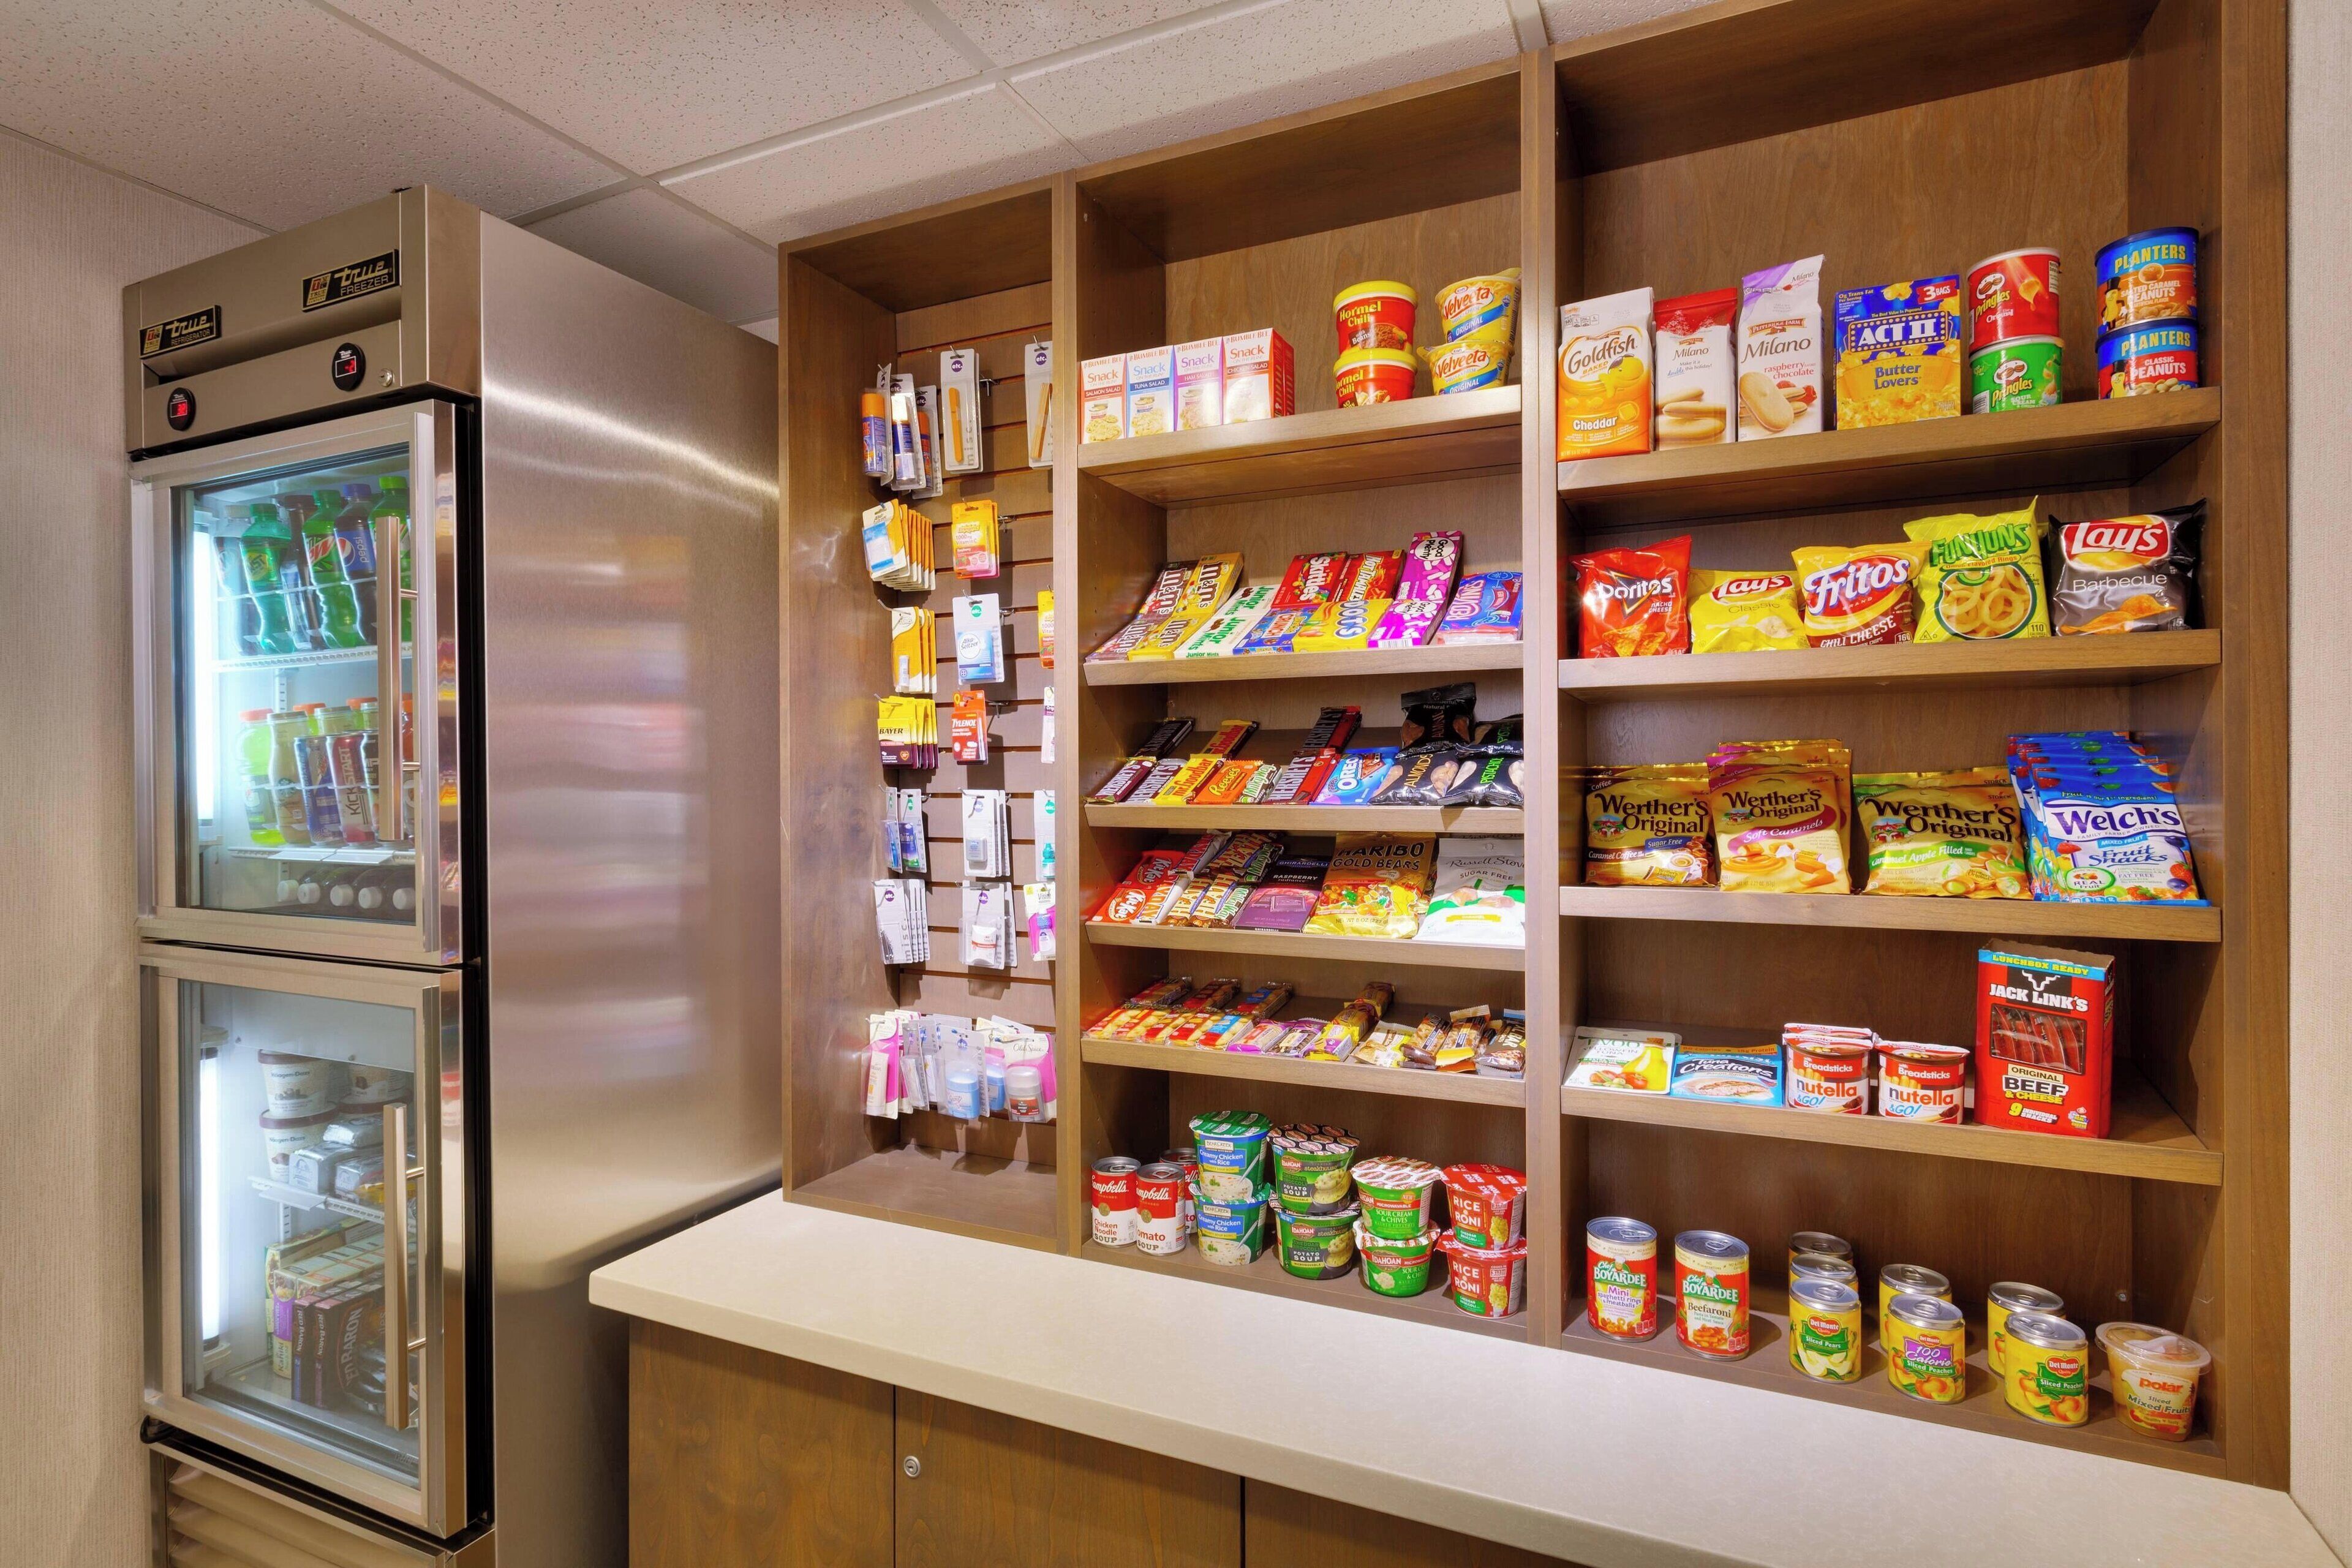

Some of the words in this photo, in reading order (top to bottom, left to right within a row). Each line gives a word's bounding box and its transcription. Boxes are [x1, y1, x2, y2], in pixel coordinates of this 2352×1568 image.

[2114, 244, 2186, 273] PLANTERS
[341, 274, 388, 296] FREEZER
[2149, 280, 2181, 289] CARAMEL
[1923, 285, 1936, 301] 3
[1936, 285, 1950, 296] BAGS
[2128, 288, 2176, 304] PEANUTS
[1444, 286, 1491, 318] Velveeta
[1975, 289, 2010, 322] Pringles
[1340, 301, 1381, 322] Hormel
[1348, 315, 1371, 327] Chili
[1456, 316, 1483, 336] ORIGINAL
[1352, 333, 1371, 344] Beans
[1858, 323, 1905, 346] ACT
[1909, 318, 1937, 339] II
[1231, 344, 1265, 359] Snack
[1741, 336, 1811, 364] Milano
[2121, 331, 2191, 356] PLANTERS
[1182, 353, 1214, 368] Snack
[1568, 333, 1637, 375] Goldfish
[1672, 347, 1709, 361] Milano
[2145, 356, 2174, 366] CLASSIC
[1134, 363, 1166, 376] Snack
[1436, 350, 1488, 377] Velveeta
[1582, 360, 1609, 375] BAKED
[1763, 361, 1806, 375] raspberry
[1875, 364, 1921, 378] Butter
[2130, 363, 2186, 380] PEANUTS
[1088, 369, 1118, 383] Snack
[1773, 368, 1814, 380] chocolate
[1339, 383, 1355, 397] Chili
[1449, 379, 1479, 394] ORIGINAL
[1874, 377, 1918, 390] Lovers
[1992, 377, 2032, 407] Pringles
[1572, 416, 1618, 431] Cheddar
[2069, 522, 2163, 555] Lay's
[359, 536, 369, 564] pepsi
[1435, 539, 1449, 557] Good
[1300, 556, 1330, 601] Skittles
[2073, 573, 2168, 593] Barbecue
[1597, 576, 1672, 600] Doritos
[1803, 559, 1910, 616] Fritos
[1243, 586, 1275, 609] Junior
[1728, 601, 1781, 614] Classic
[1335, 600, 1370, 639] DOTS
[1211, 617, 1246, 644] Junior
[1849, 615, 1896, 644] CHEESE
[960, 641, 979, 650] Seltzer
[1188, 632, 1215, 650] Mints
[951, 719, 976, 728] TYLENOL
[1337, 757, 1359, 789] OREO
[1403, 753, 1433, 788] ALMONDS
[1208, 767, 1241, 796] Reese's
[1594, 793, 1709, 817] Werther's
[1722, 788, 1822, 809] Werther's
[1749, 802, 1820, 820] Original
[1865, 796, 2018, 826] Werther's
[1622, 814, 1704, 837] Original
[2051, 807, 2180, 835] Welch's
[1744, 829, 1768, 843] Soft
[1770, 818, 1823, 837] Caramels
[1905, 816, 2013, 843] Original
[1648, 839, 1667, 848] Sugar
[2124, 835, 2143, 844] FRUIT
[1337, 842, 1425, 857] HARIBO
[1908, 849, 1936, 864] Apple
[1938, 845, 1964, 856] Filled
[1333, 859, 1371, 868] GOLD
[1378, 859, 1420, 870] BEARS
[1450, 858, 1492, 867] Russell
[2089, 854, 2168, 867] Snacks
[1460, 870, 1488, 879] SUGAR
[1992, 954, 2049, 969] LUNCHBOX
[2052, 963, 2089, 975] READY
[1989, 983, 2029, 1003] JACK
[2032, 991, 2089, 1012] LINK'S
[1680, 1063, 1773, 1077] Creations
[1803, 1060, 1853, 1072] Breadsticks
[1898, 1066, 1950, 1079] Breadsticks
[2011, 1066, 2060, 1083] ORIGINAL
[1796, 1077, 1857, 1098] nutella
[2004, 1076, 2067, 1097] BEEF
[1890, 1087, 1954, 1106] nutella
[2016, 1091, 2063, 1104] CHEESE
[1200, 1150, 1218, 1159] Creamy
[1453, 1196, 1480, 1212] RICE
[1095, 1219, 1117, 1229] Chicken
[1199, 1214, 1215, 1225] Creamy
[1455, 1213, 1481, 1227] RONI
[1095, 1226, 1117, 1235] Noodle
[1095, 1234, 1117, 1243] SOUP
[1137, 1240, 1159, 1251] SOUP
[1372, 1256, 1401, 1264] IDAHOAN
[1453, 1261, 1479, 1278] RICE
[1594, 1267, 1647, 1287] BOYARDEE
[1455, 1279, 1480, 1294] RONI
[1608, 1285, 1630, 1297] Mini
[1683, 1281, 1739, 1303] BOYARDEE
[1687, 1302, 1731, 1318] Beefaroni
[1820, 1321, 1839, 1330] Monte
[1806, 1335, 1823, 1345] Sliced
[1825, 1339, 1841, 1349] Pears
[1928, 1365, 1953, 1374] Peaches
[2049, 1360, 2060, 1369] Del
[2060, 1361, 2079, 1370] Monte
[2040, 1379, 2061, 1389] Sliced
[2128, 1394, 2162, 1412] Mixed
[2147, 1396, 2171, 1404] Sliced
